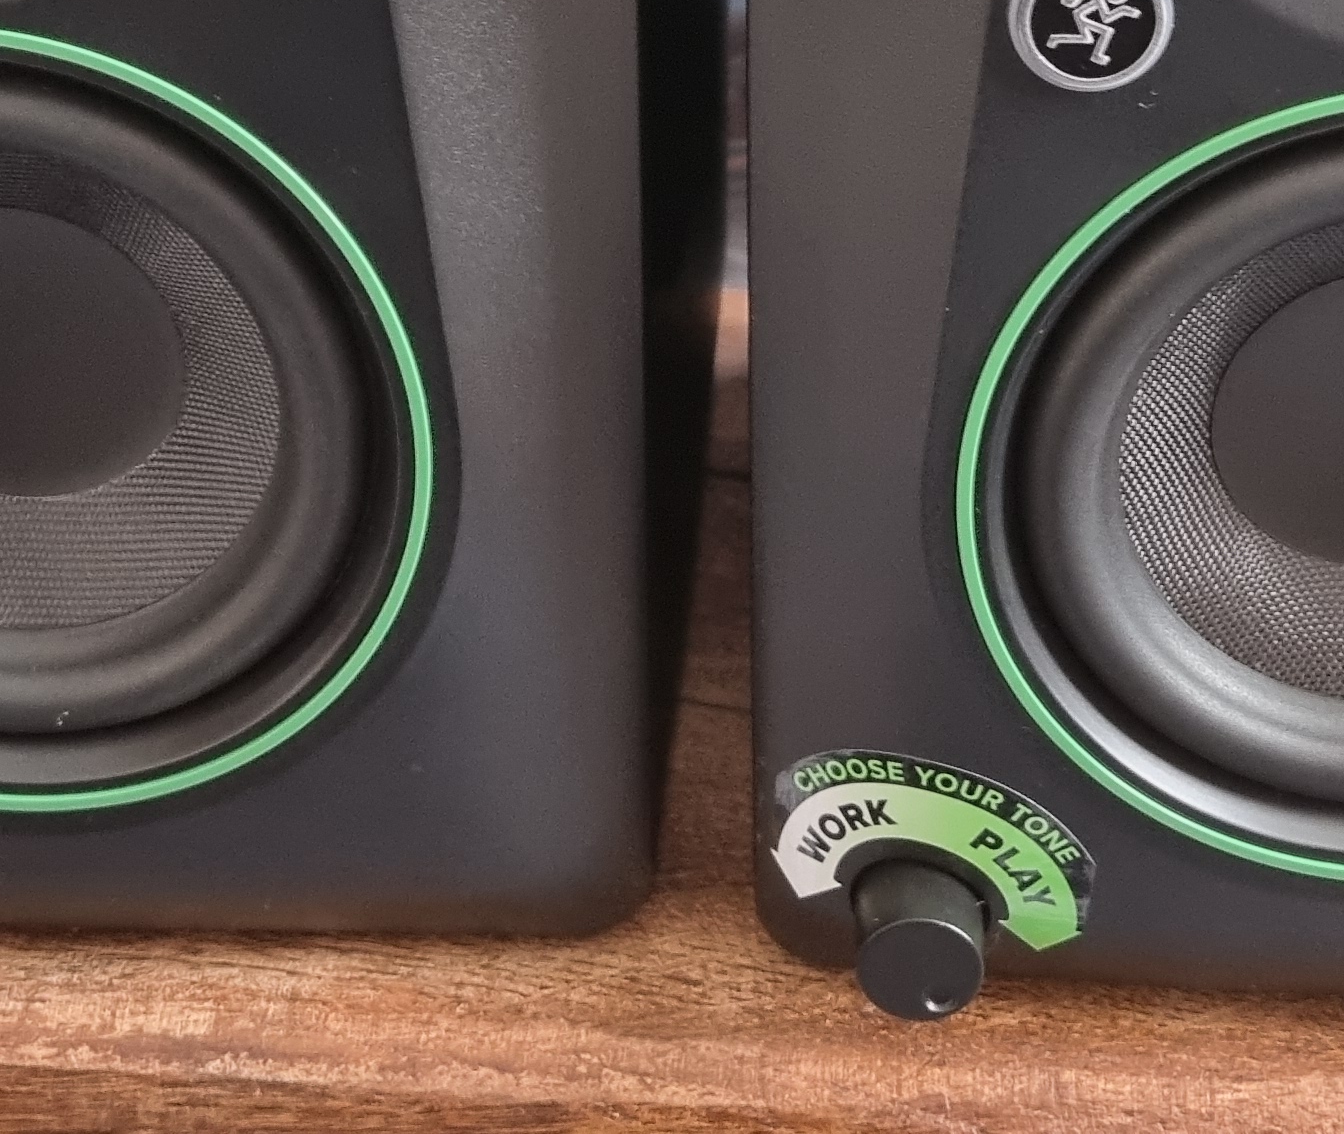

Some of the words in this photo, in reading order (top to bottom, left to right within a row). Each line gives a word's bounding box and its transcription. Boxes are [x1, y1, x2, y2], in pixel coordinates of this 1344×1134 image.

[793, 758, 905, 792] CHOOSE
[915, 766, 1004, 811] YOUR
[1011, 804, 1080, 864] TONE
[797, 799, 897, 863] WORK
[969, 828, 1056, 908] PLAY
